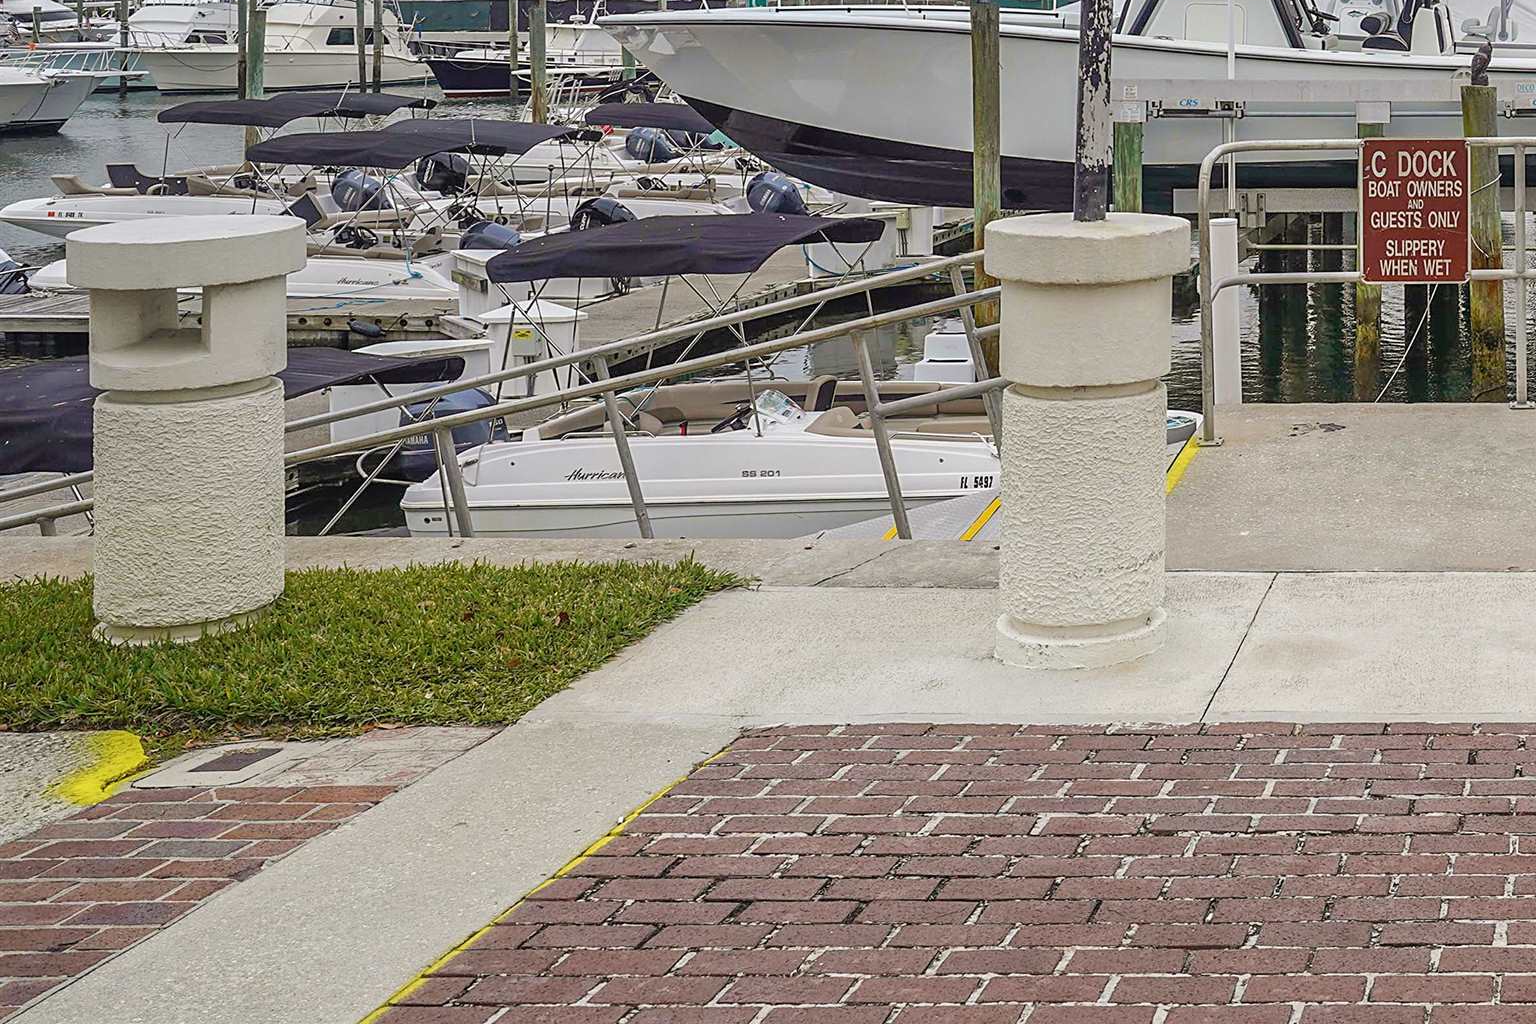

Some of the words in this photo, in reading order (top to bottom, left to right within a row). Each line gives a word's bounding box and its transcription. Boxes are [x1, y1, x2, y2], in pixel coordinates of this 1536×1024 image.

[1179, 97, 1200, 107] CRS
[1371, 150, 1387, 178] C
[1398, 150, 1457, 178] DOCK
[1368, 180, 1401, 198] BOAT
[1407, 180, 1463, 198] OWNERS
[1407, 199, 1424, 210] AND
[1370, 211, 1422, 229] GUESTS
[1428, 211, 1461, 228] ONLY
[1386, 239, 1445, 257] SLIPPERY
[1380, 259, 1418, 276] WHEN
[1424, 259, 1452, 276] WET
[564, 467, 625, 481] Hurrican
[741, 470, 757, 478] SS
[760, 470, 781, 478] 201
[960, 476, 969, 489] FL
[973, 475, 994, 489] 5497
